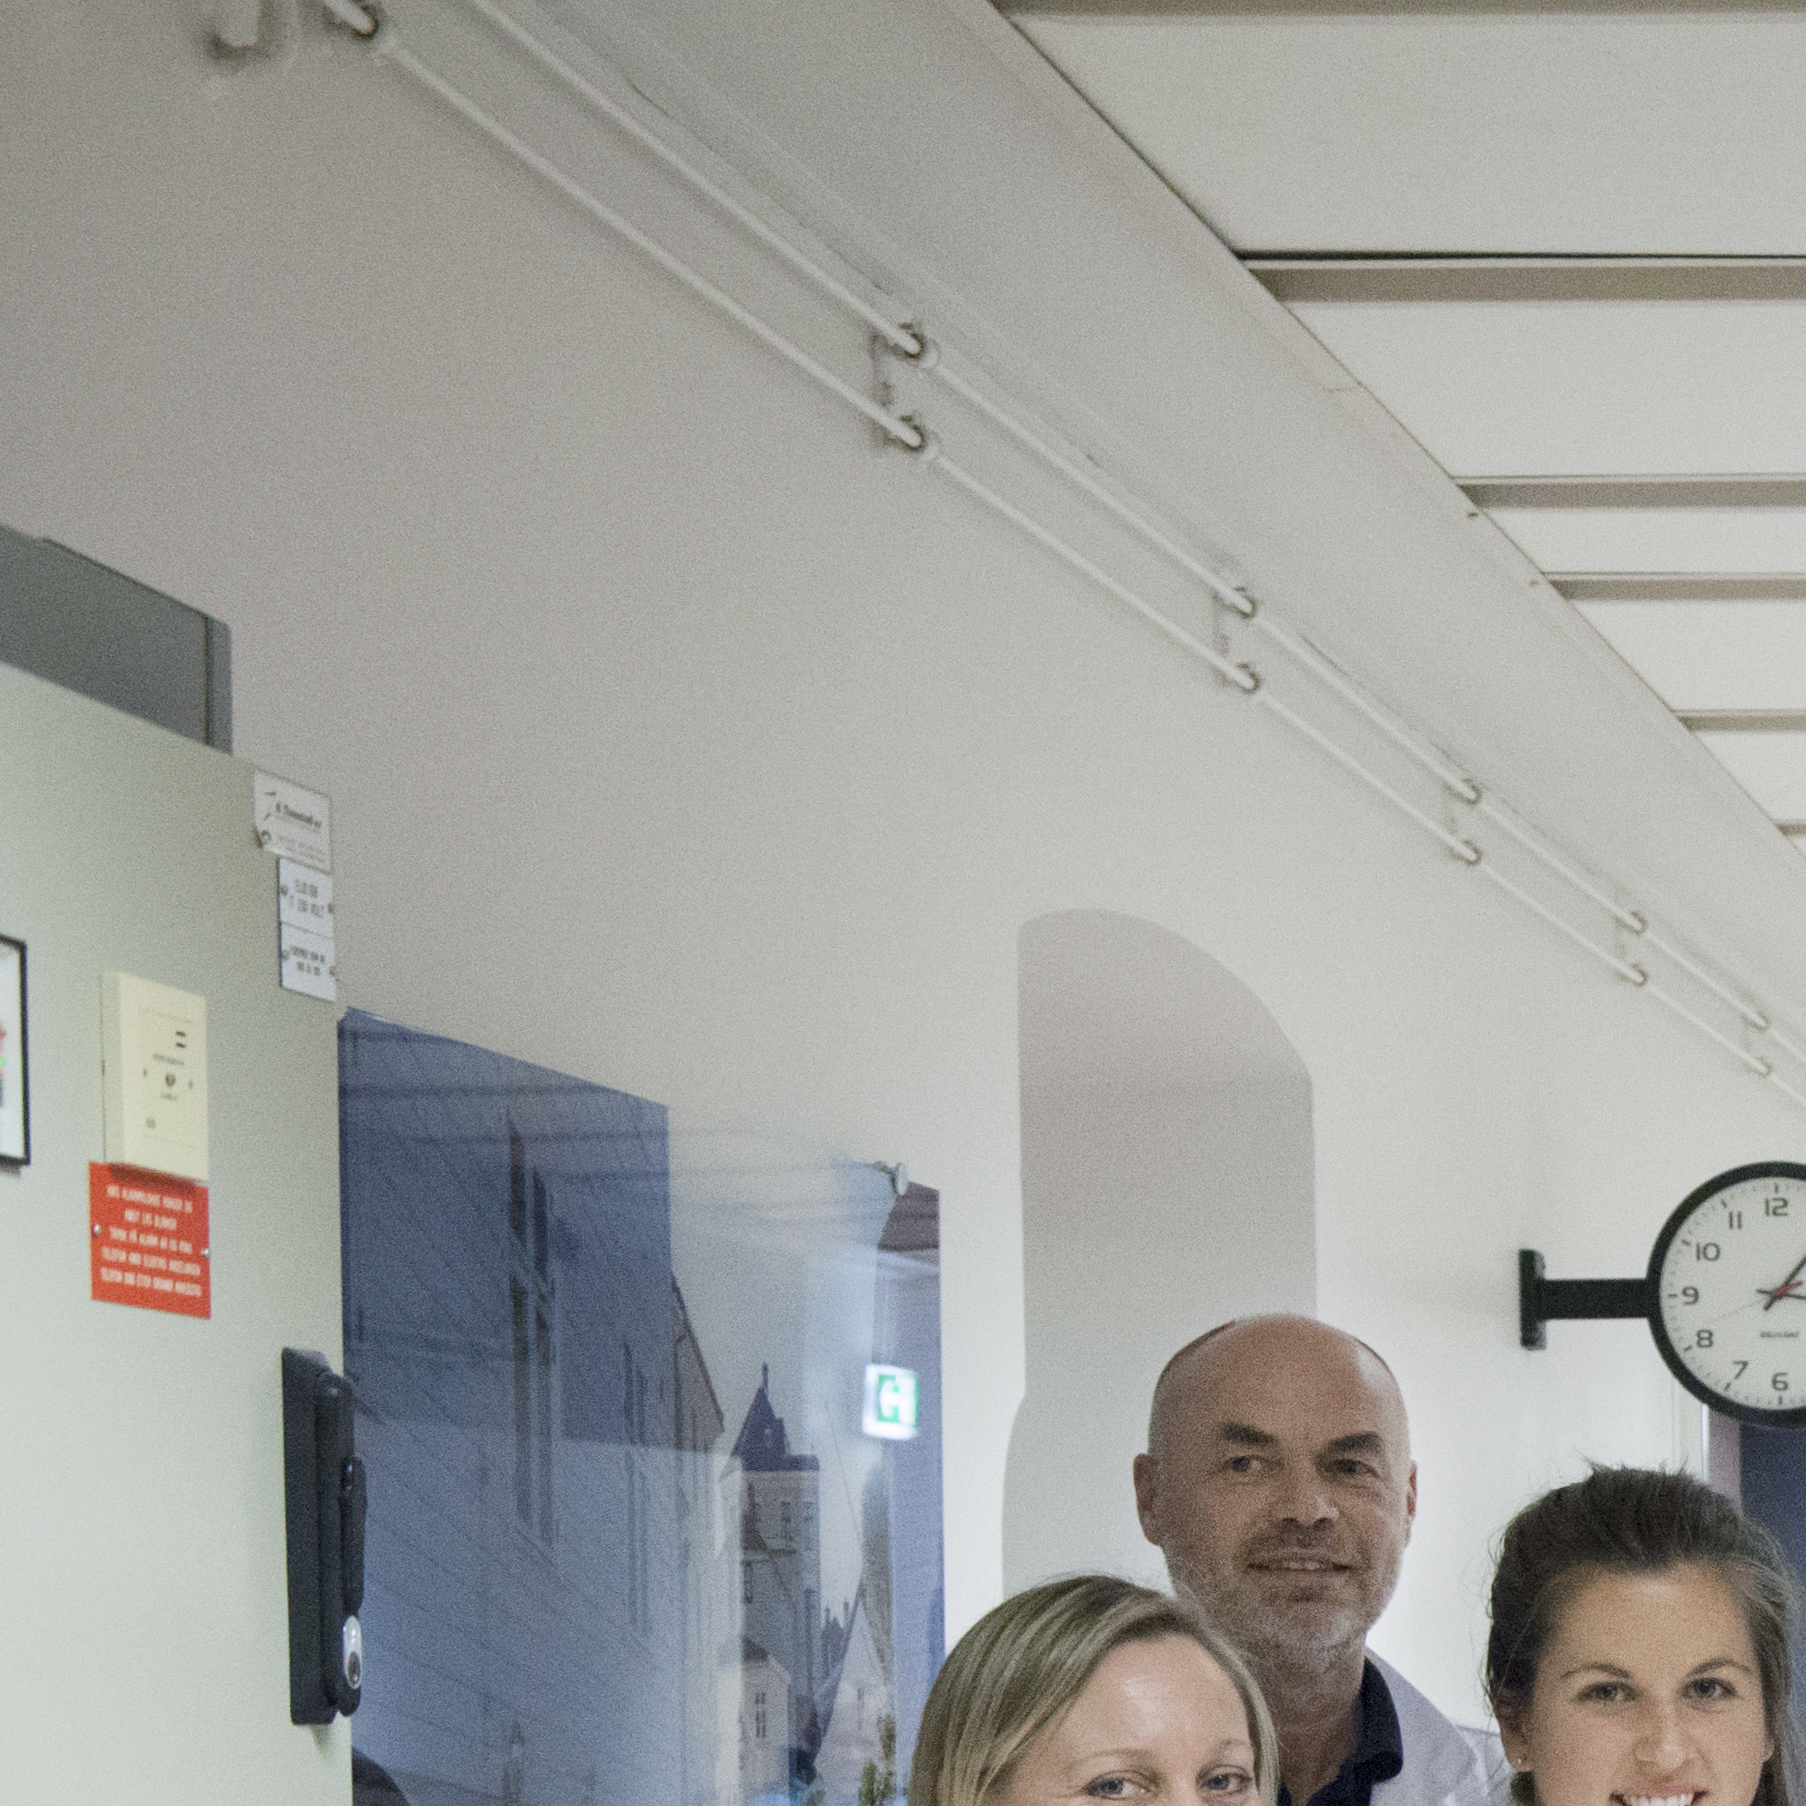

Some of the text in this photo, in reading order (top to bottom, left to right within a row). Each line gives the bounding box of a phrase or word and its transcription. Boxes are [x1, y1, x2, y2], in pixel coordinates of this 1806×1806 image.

[1764, 1197, 1788, 1216] 12
[1728, 1211, 1742, 1229] 11
[1695, 1242, 1720, 1261] 10
[1681, 1286, 1699, 1305] 9
[1695, 1329, 1713, 1348] 8
[1732, 1360, 1748, 1379] 7
[1771, 1372, 1788, 1390] 6
